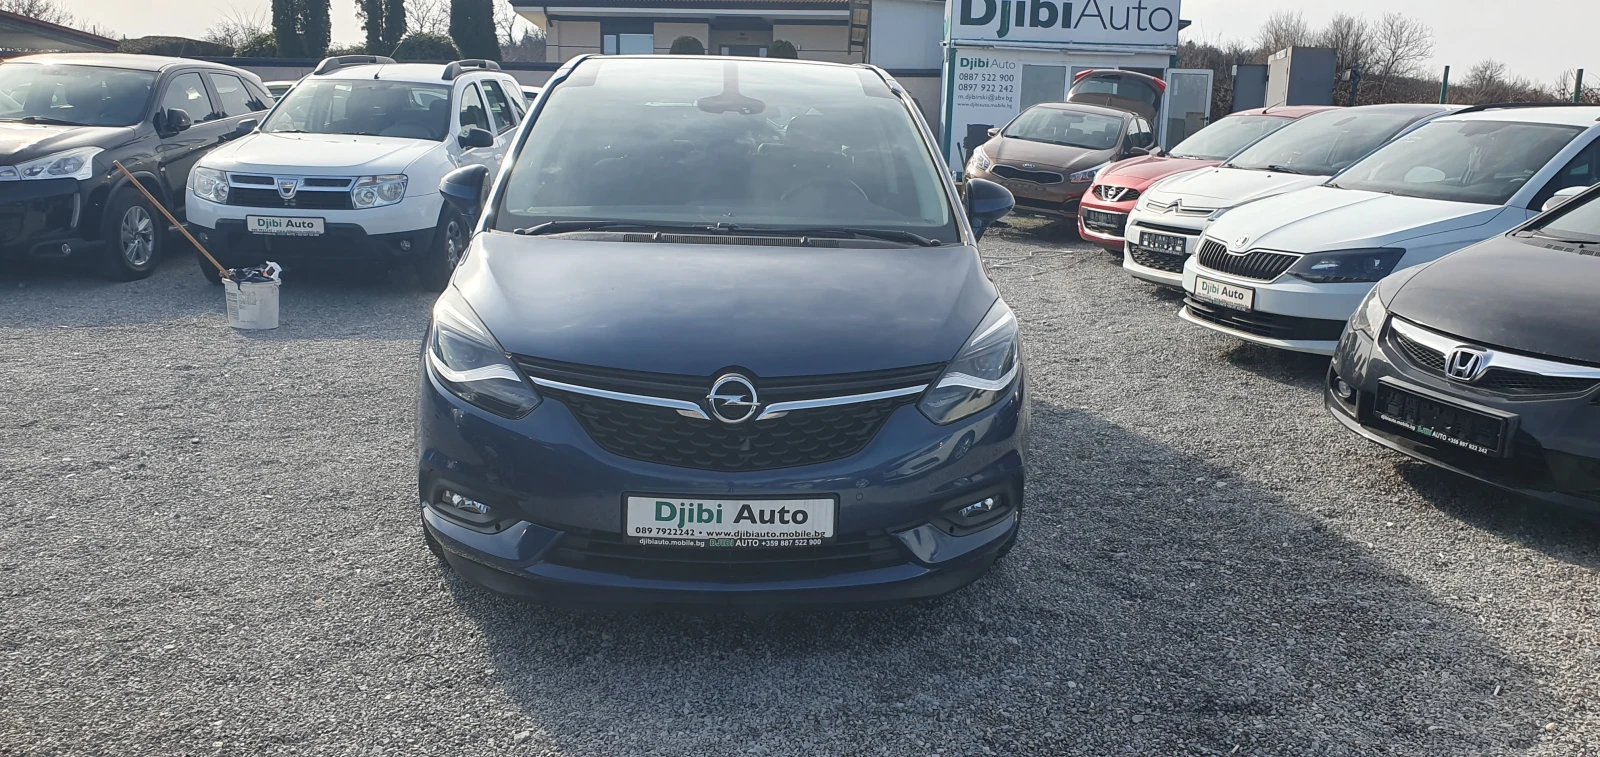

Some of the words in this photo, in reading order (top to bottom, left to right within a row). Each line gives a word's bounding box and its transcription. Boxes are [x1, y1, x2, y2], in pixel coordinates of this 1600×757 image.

[960, 57, 989, 70] Djibi
[990, 59, 1016, 70] Auto
[959, 73, 979, 81] 0887
[981, 73, 997, 82] 522
[999, 74, 1015, 82] 900
[958, 83, 978, 92] 0897
[980, 84, 996, 93] 922
[998, 84, 1014, 93] 242
[257, 218, 282, 229] Djibi
[285, 219, 314, 229] Auto
[1201, 281, 1220, 295] Djibi
[1221, 286, 1244, 300] Auto
[1431, 430, 1447, 441] AUTO
[655, 500, 723, 529] Djibi
[733, 503, 809, 525] Auto
[635, 526, 653, 535] 089
[655, 527, 695, 536] 7922242
[706, 530, 826, 538] www.djibiauto.mobile.bg
[639, 538, 705, 547] djibiauto.mobile.bg
[735, 539, 759, 547] AUTO
[808, 538, 822, 546] 900
